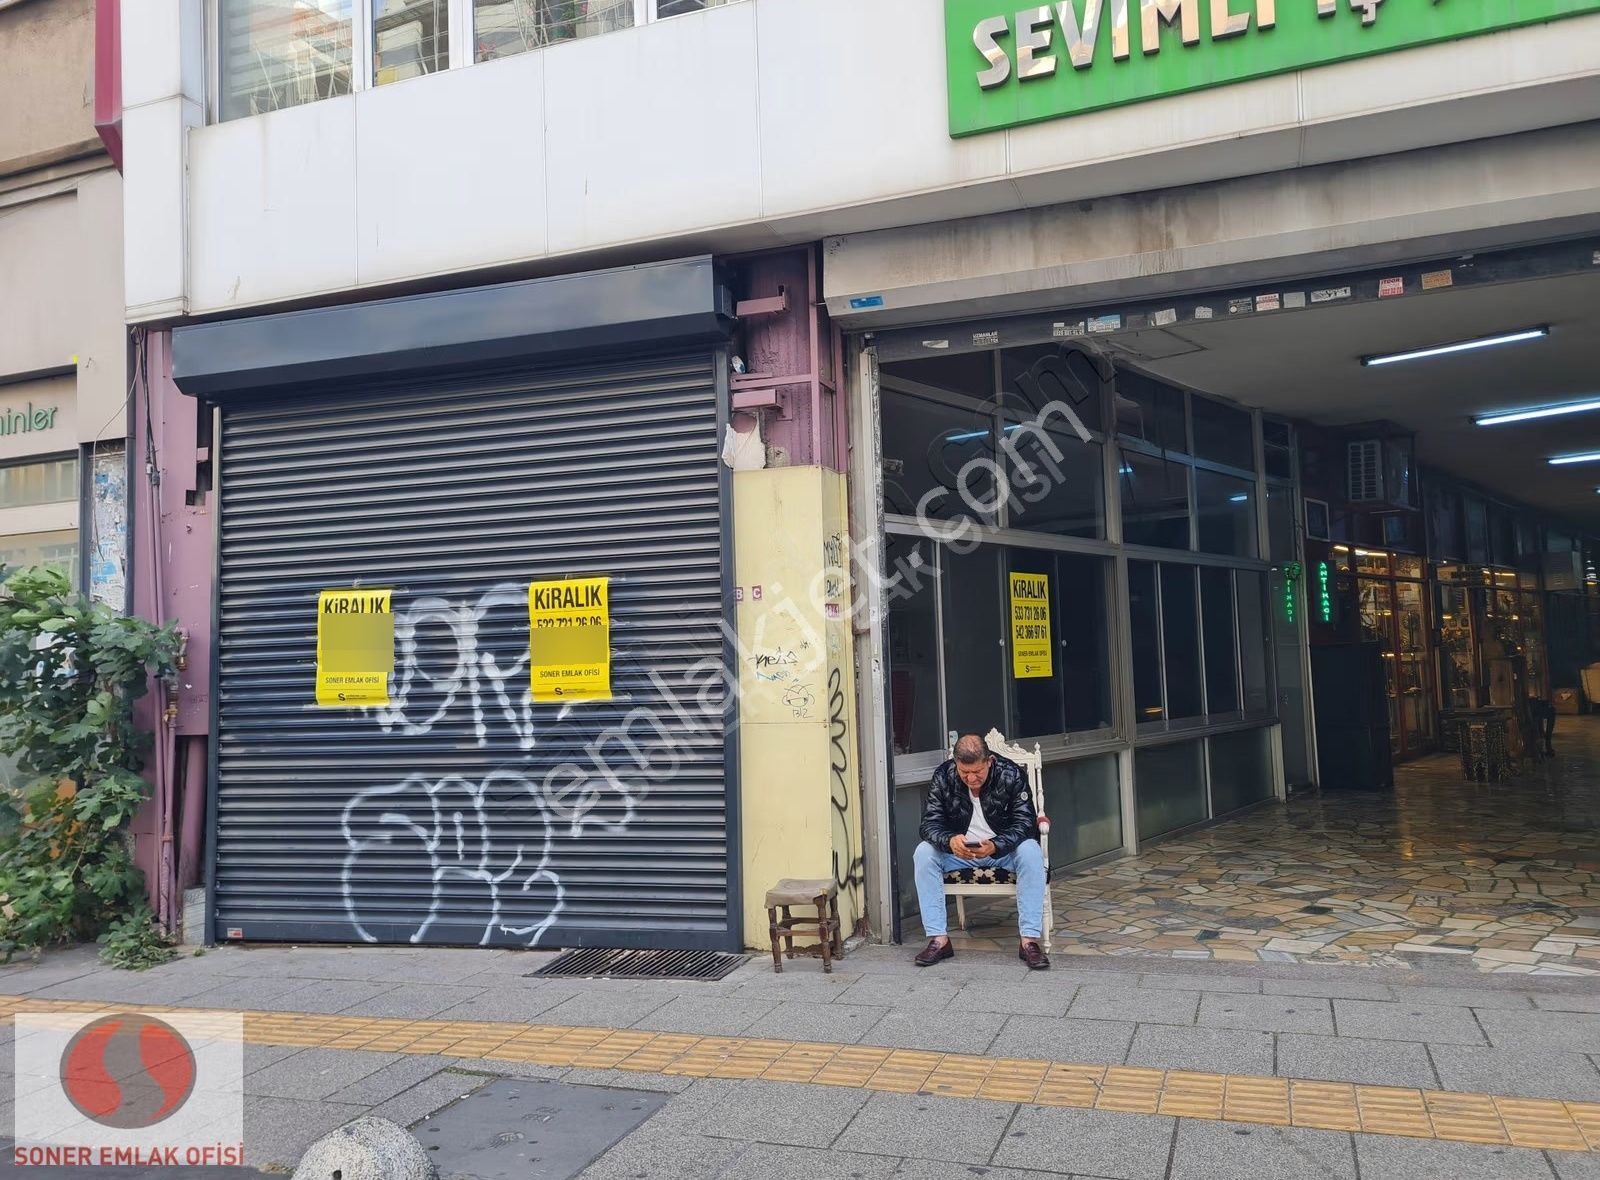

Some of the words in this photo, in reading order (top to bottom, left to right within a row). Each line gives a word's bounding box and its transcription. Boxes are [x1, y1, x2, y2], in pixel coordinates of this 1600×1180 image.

[753, 588, 761, 599] C
[540, 670, 560, 678] SONER
[561, 669, 582, 677] EMLAK
